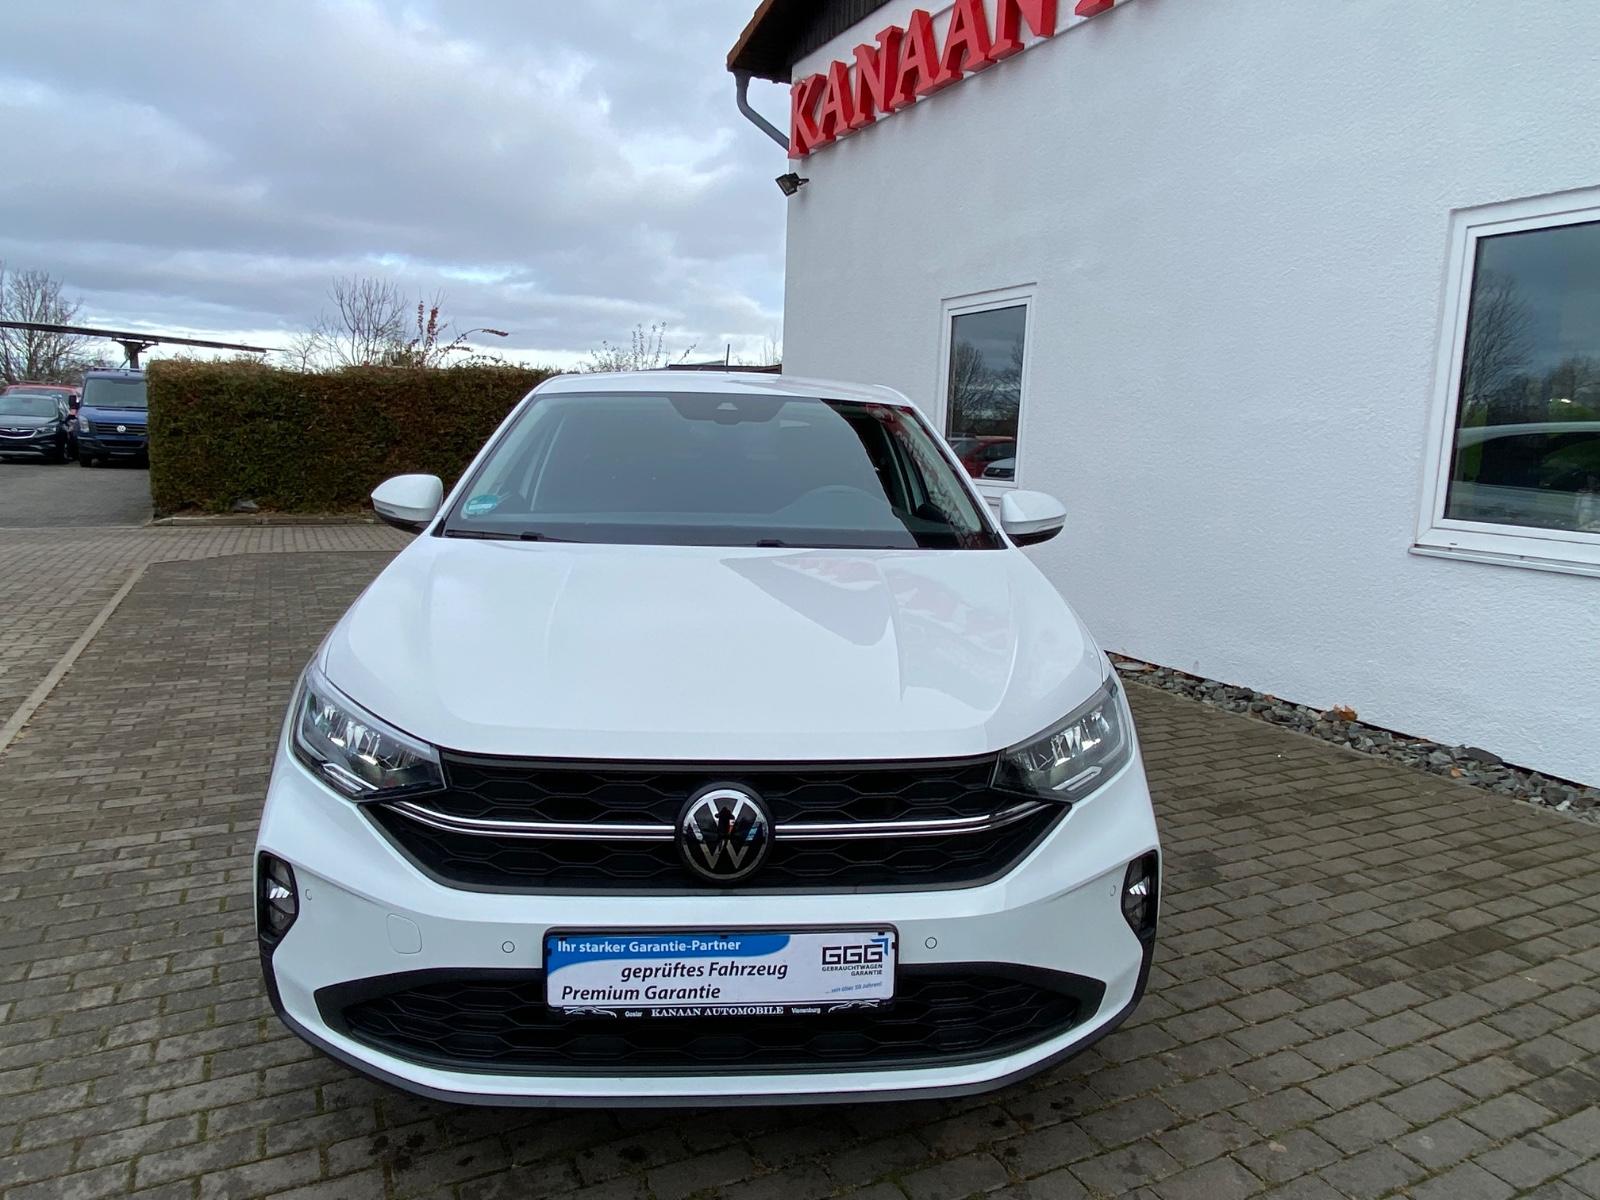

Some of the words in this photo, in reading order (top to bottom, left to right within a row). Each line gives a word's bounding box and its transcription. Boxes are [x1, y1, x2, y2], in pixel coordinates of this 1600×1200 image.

[557, 941, 576, 952] Ihr
[579, 941, 625, 953] starker
[629, 940, 741, 952] Garantie-Partner
[822, 944, 883, 965] GGG
[621, 962, 705, 982] geprüftes
[708, 961, 788, 979] Fahrzeug
[821, 964, 883, 972] GEBRAUCHTWAGEN
[561, 985, 640, 1000] Premium
[644, 984, 721, 1000] Garantie
[651, 1008, 702, 1017] KANAAN
[704, 1006, 784, 1016] AUTOMOBILE
